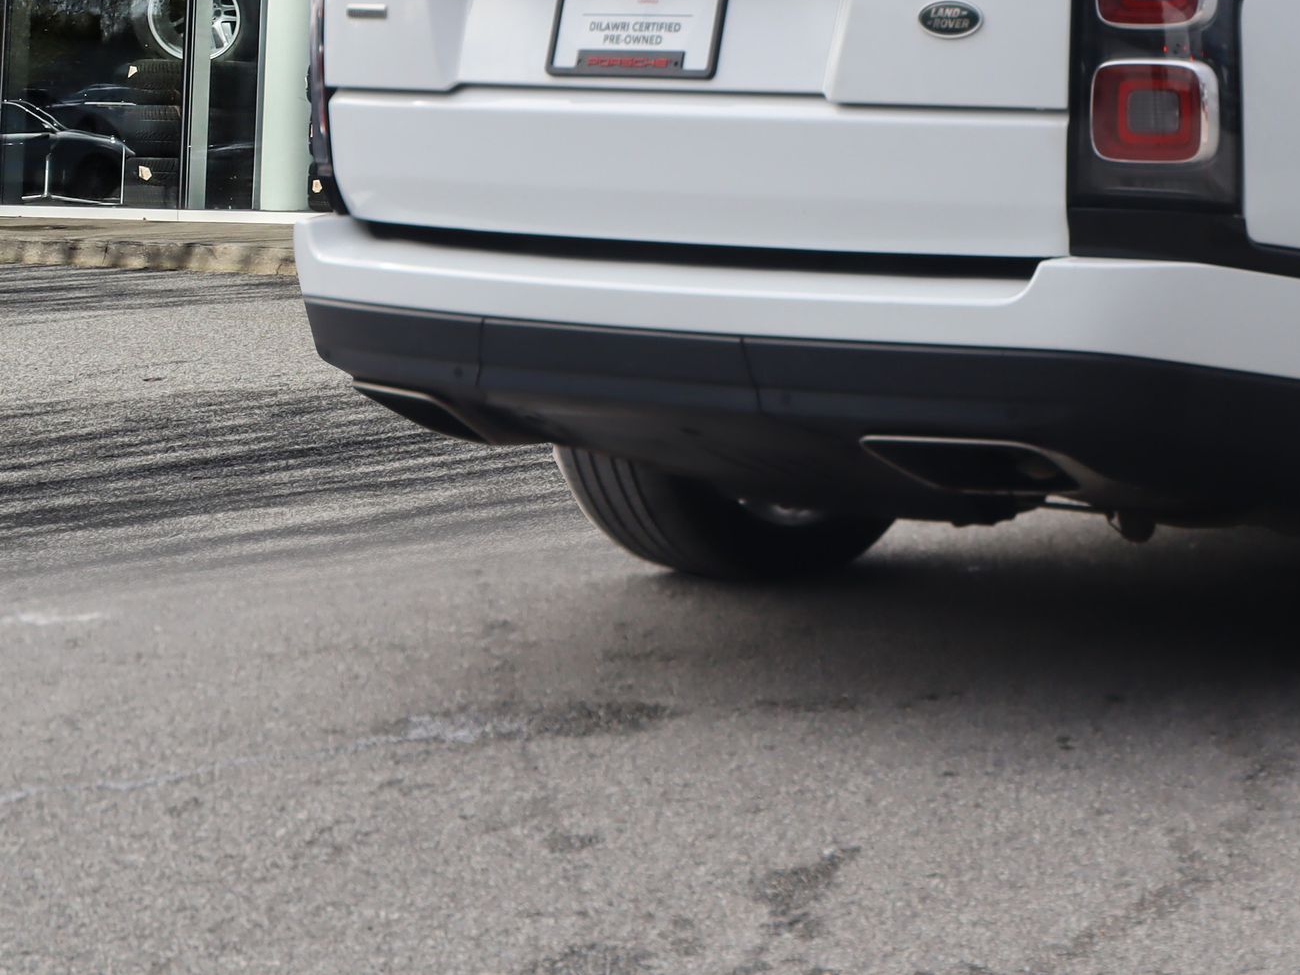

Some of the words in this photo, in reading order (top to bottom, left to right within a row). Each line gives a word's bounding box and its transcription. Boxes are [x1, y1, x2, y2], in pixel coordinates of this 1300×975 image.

[588, 21, 630, 33] DILAWRI
[631, 21, 682, 34] CERTIFIED
[933, 18, 970, 28] ROVER
[602, 34, 663, 46] PRE-OWNED
